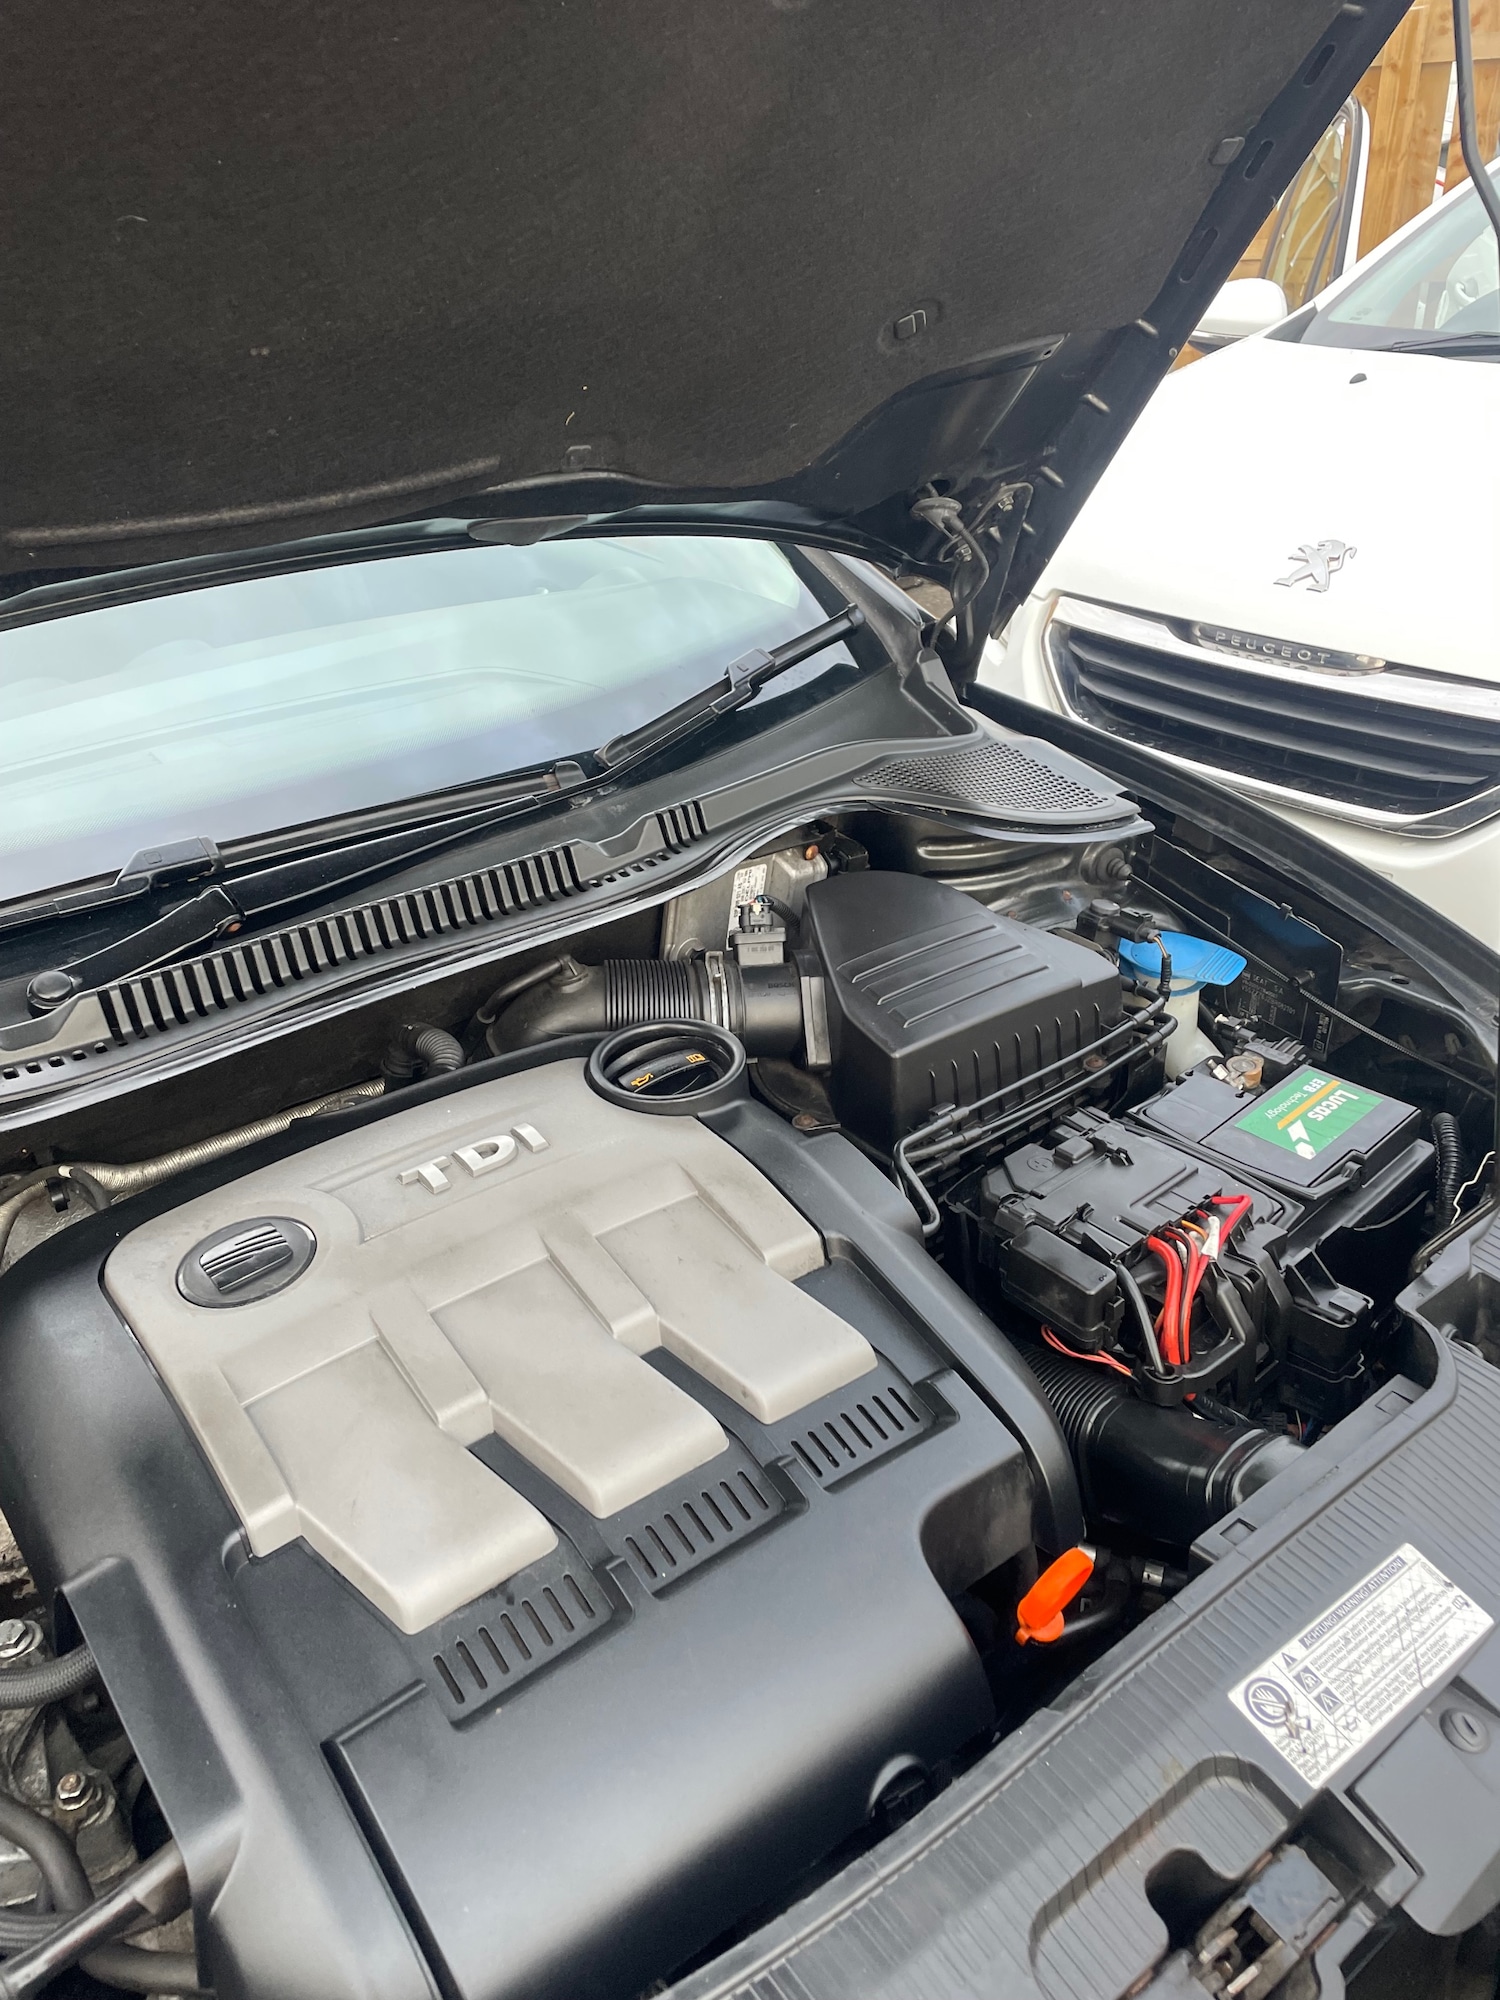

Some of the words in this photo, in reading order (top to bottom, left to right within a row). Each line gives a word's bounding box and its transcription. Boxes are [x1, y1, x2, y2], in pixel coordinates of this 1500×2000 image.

[1215, 630, 1331, 665] PEUGEOT
[1302, 1077, 1328, 1093] EFB
[1264, 1091, 1308, 1120] Technology
[1306, 1089, 1360, 1122] Lucas
[397, 1122, 551, 1195] TDI
[1301, 1612, 1340, 1646] ACHTUNG!
[1334, 1586, 1371, 1618] WARNING!
[1365, 1557, 1404, 1591] ATTENTION!
